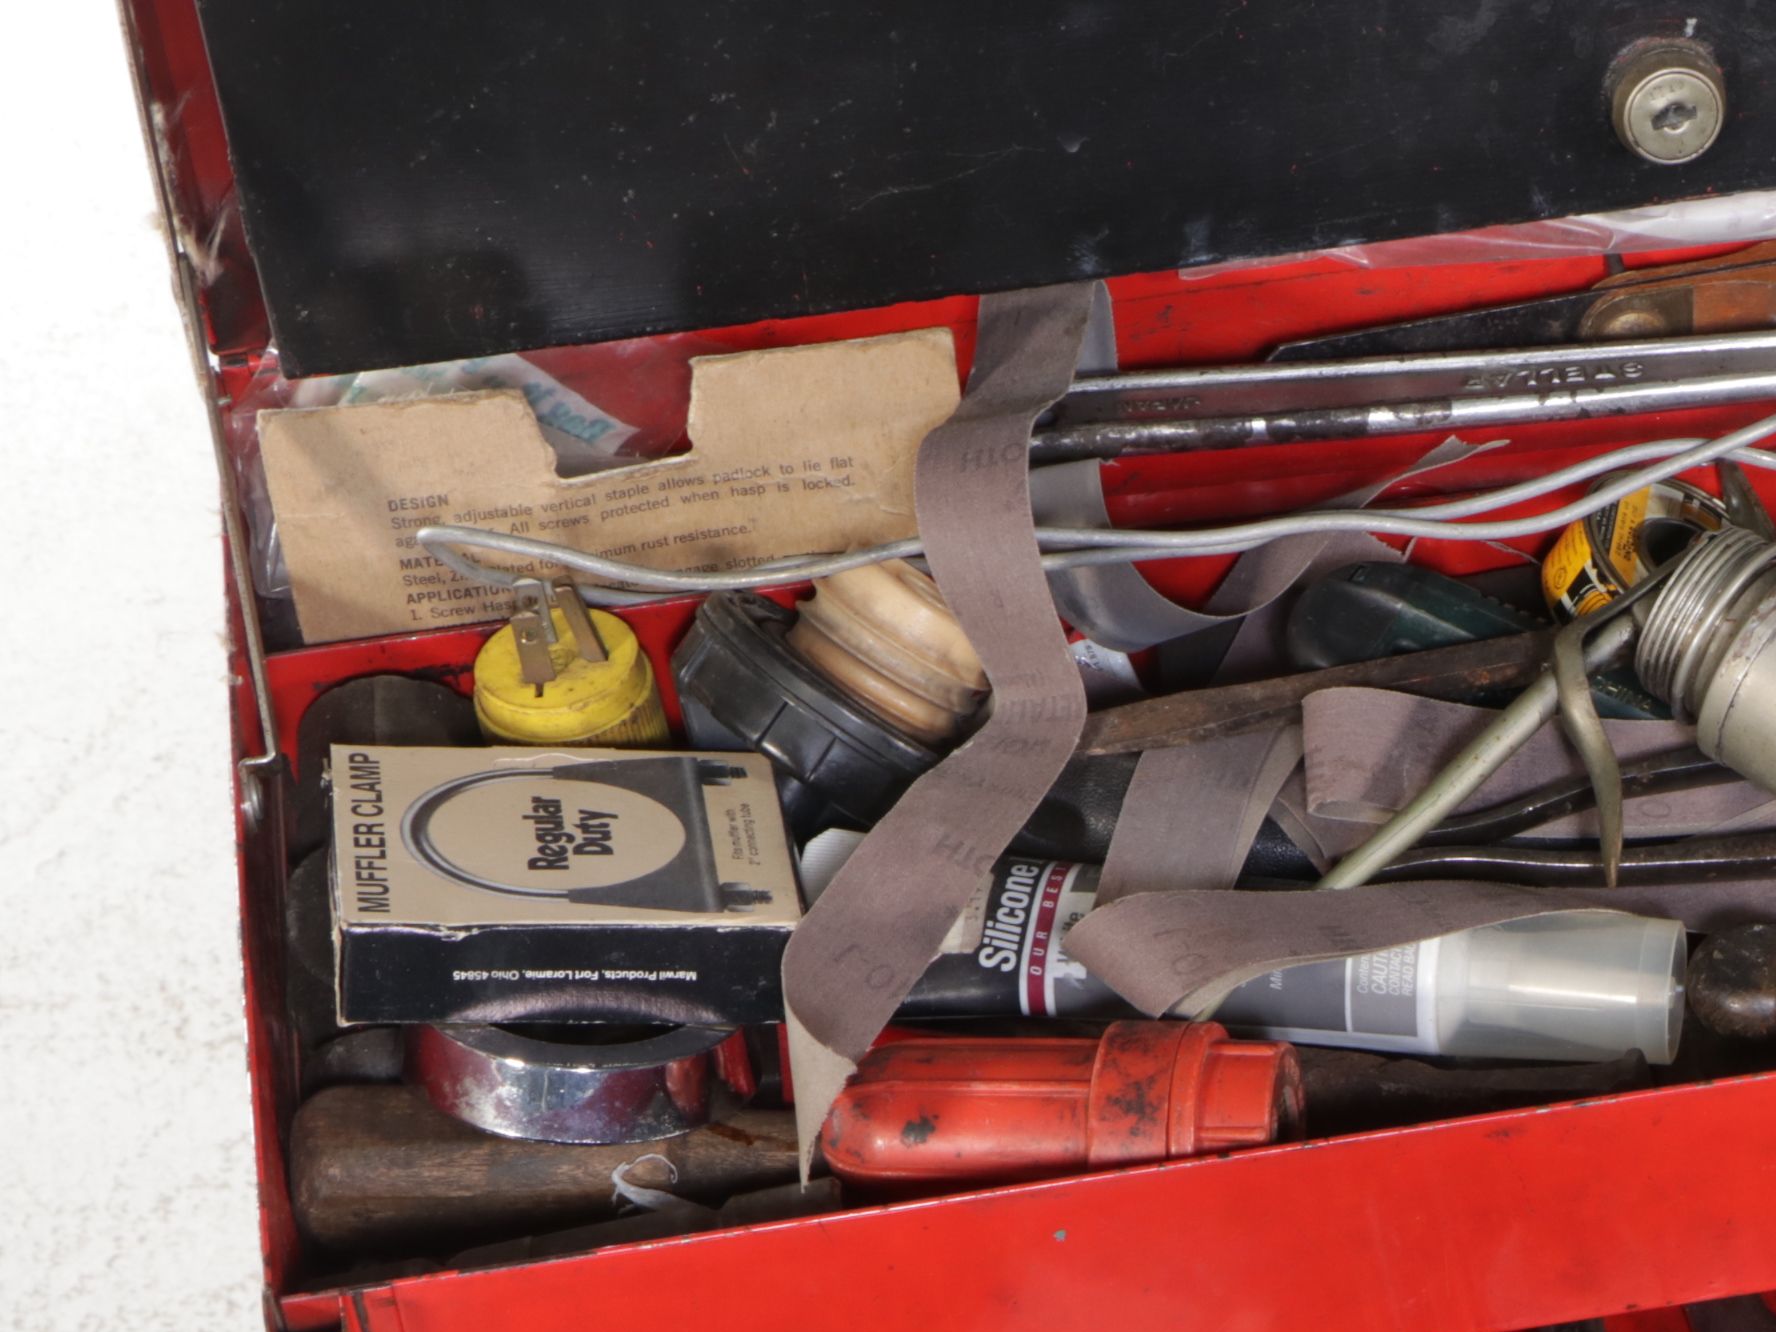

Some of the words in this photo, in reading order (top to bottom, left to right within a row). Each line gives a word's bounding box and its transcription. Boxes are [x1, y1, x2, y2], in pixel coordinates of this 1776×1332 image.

[387, 494, 450, 513] DESIGN
[390, 514, 447, 530] Strong,
[453, 504, 534, 524] adjustable
[540, 494, 598, 514] vertical
[604, 484, 649, 503] staple
[657, 473, 705, 493] allows
[712, 465, 771, 485] padlock
[778, 462, 795, 475] to
[802, 459, 822, 473] lie
[829, 456, 855, 470] flat
[510, 520, 530, 535] All
[537, 513, 591, 532] screws
[600, 497, 671, 522] protected
[679, 488, 720, 505] when
[729, 483, 767, 501] hasp
[776, 480, 790, 493] is
[801, 473, 856, 491] locked.
[402, 570, 447, 587] Steel,
[640, 535, 670, 551] rust
[672, 522, 752, 545] resistance.
[430, 601, 476, 620] Screw
[348, 751, 384, 818] CLAMP
[522, 795, 570, 872] Regular
[572, 807, 620, 857] Duty
[352, 821, 391, 914] MUFFLER
[977, 863, 1041, 972] Silicone
[1030, 930, 1049, 976] OUR
[452, 968, 489, 982] 45845
[490, 969, 520, 982] Ohio
[523, 969, 575, 983] Loramie,
[577, 969, 599, 982] Fort
[602, 968, 657, 983] Products,
[658, 969, 698, 982] Marwil
[1400, 971, 1414, 997] READ
